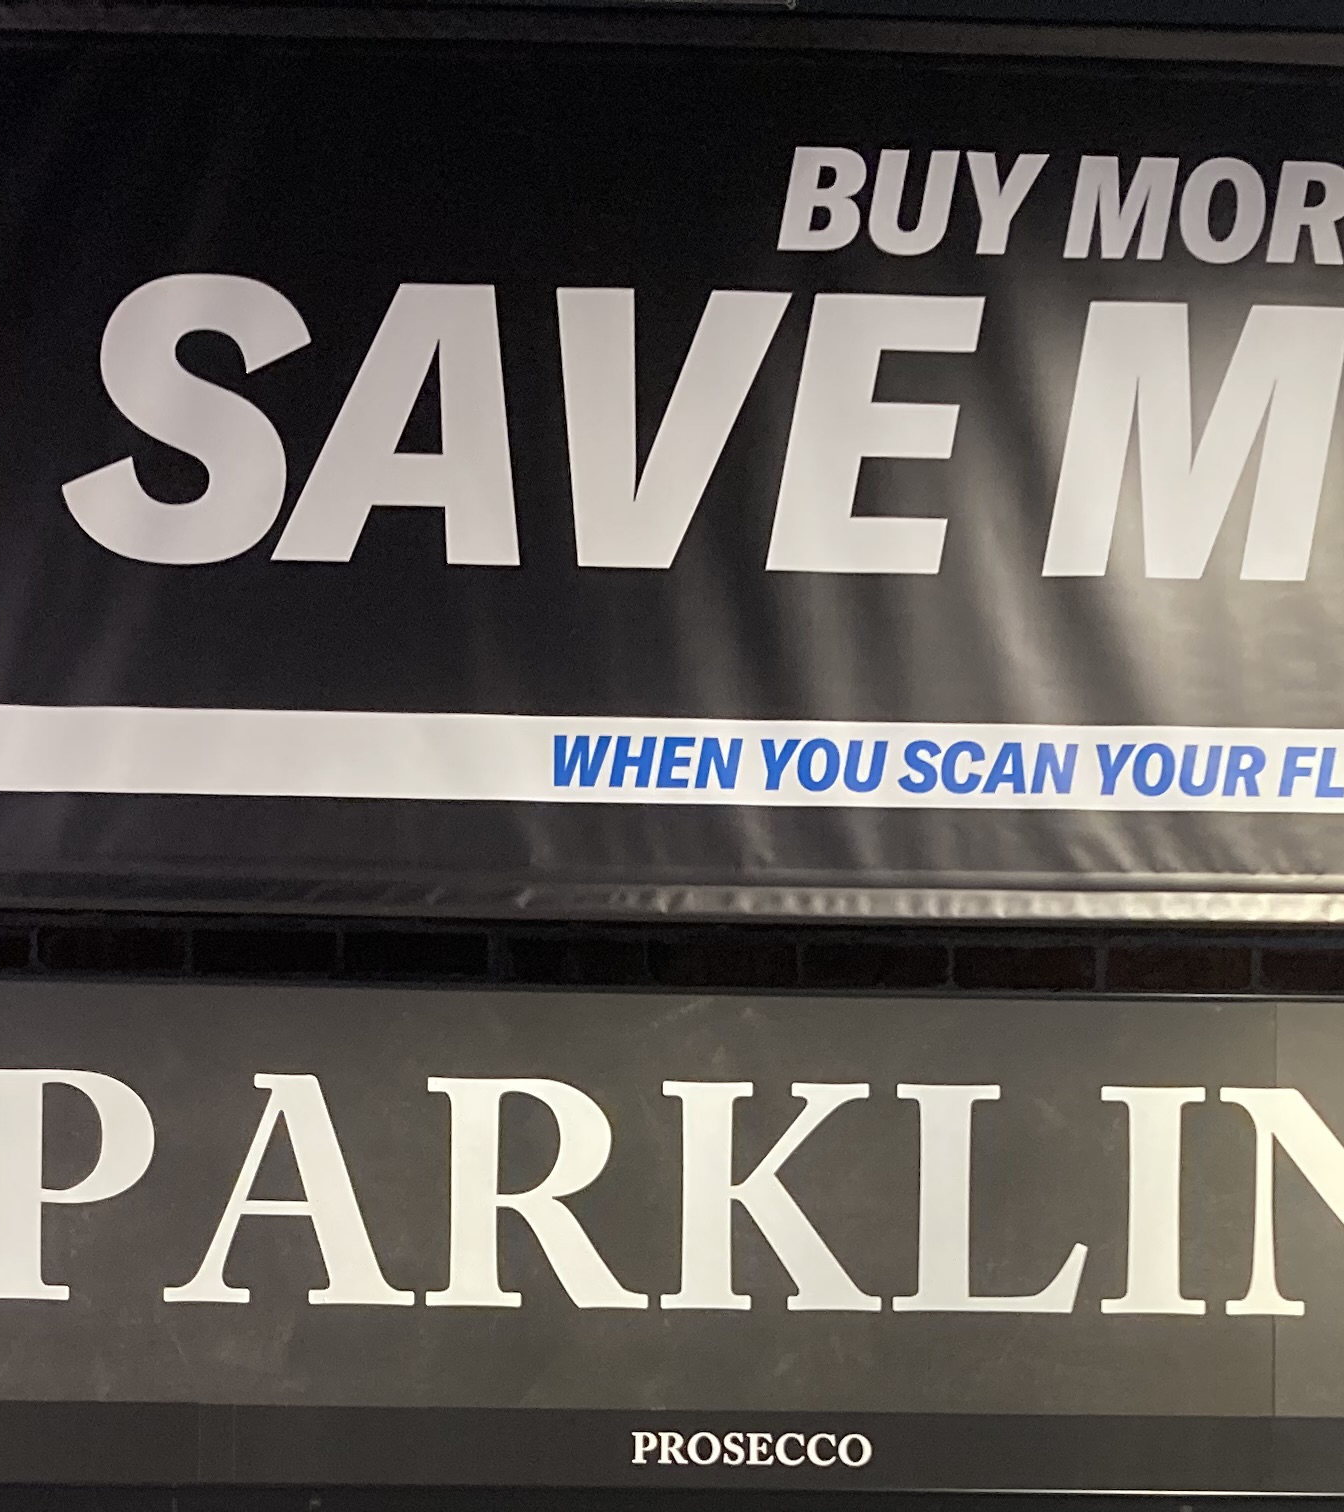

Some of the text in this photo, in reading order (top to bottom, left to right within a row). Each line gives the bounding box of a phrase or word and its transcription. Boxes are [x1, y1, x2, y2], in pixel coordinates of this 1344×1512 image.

[777, 146, 1050, 256] BUY
[61, 272, 987, 575] SAVE
[552, 733, 743, 789] WHEN
[759, 736, 890, 795] YOU
[897, 738, 1078, 796] SCAN
[1094, 742, 1268, 798] YOUR
[630, 1430, 873, 1469] PROSECCO
